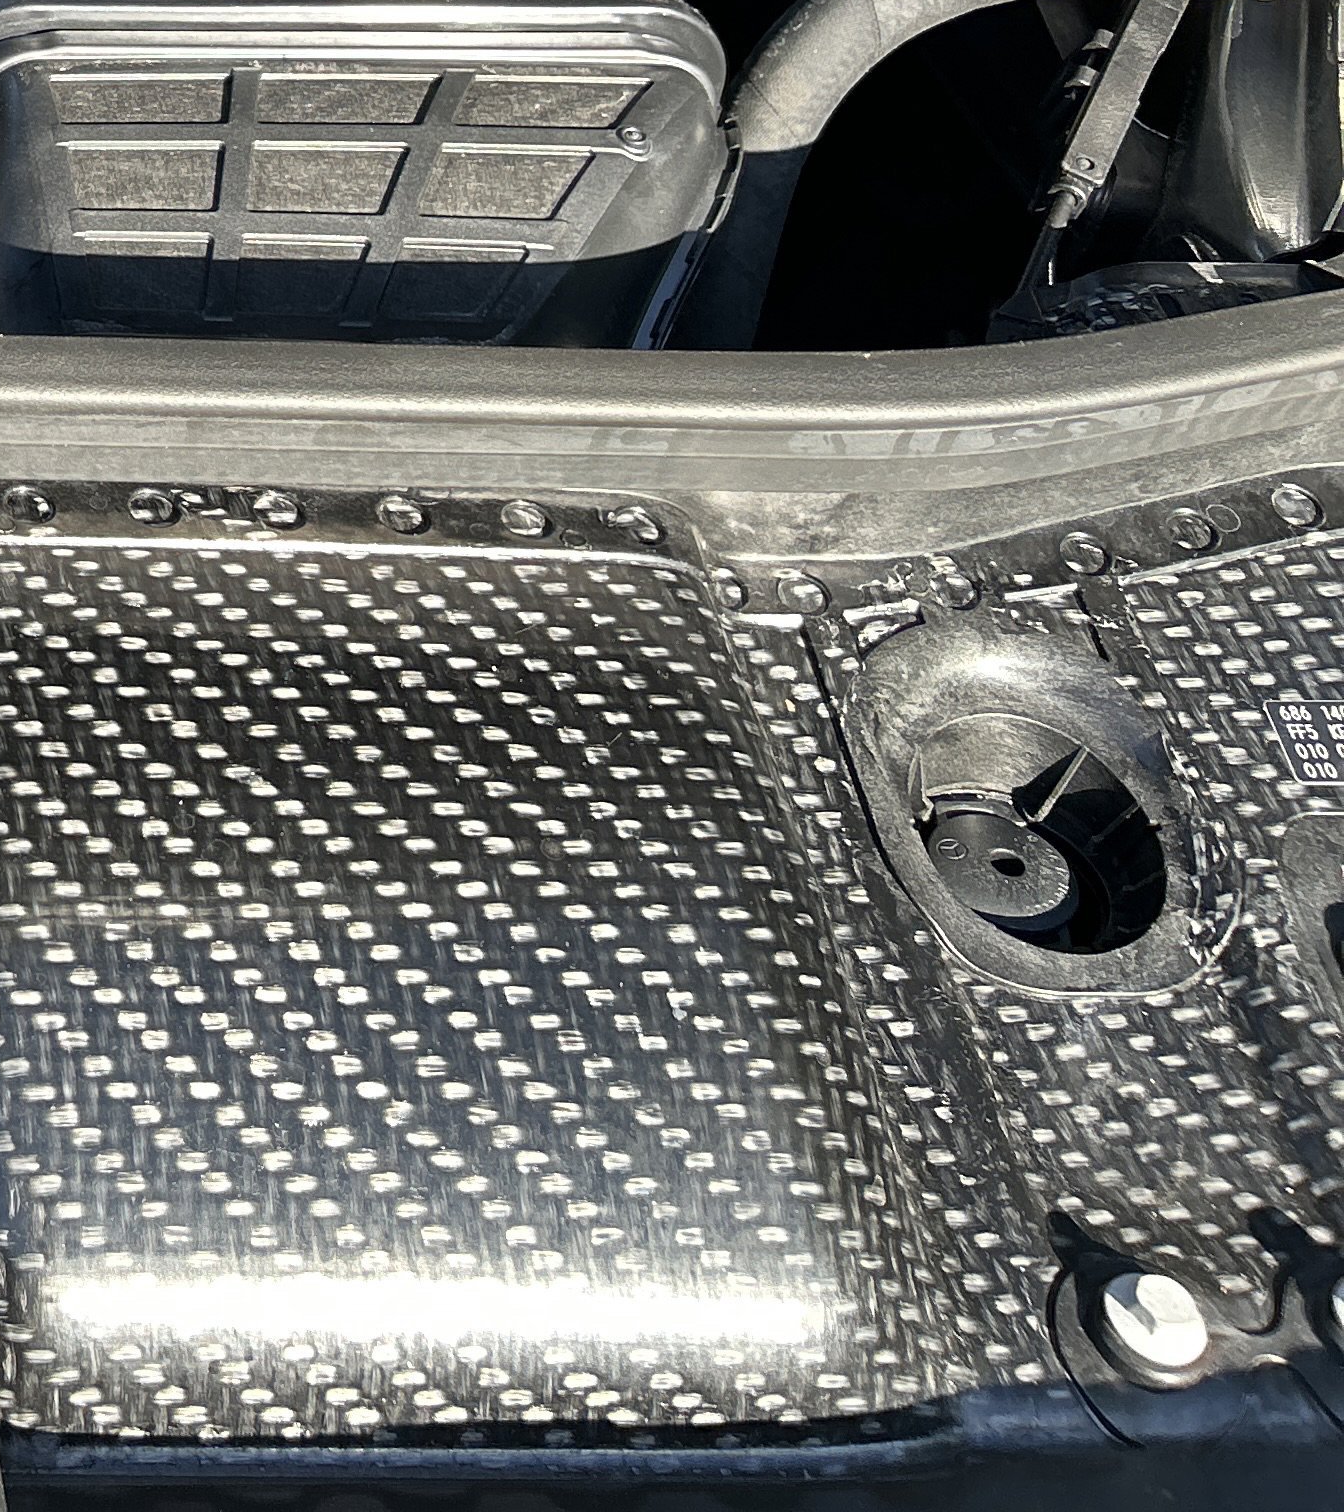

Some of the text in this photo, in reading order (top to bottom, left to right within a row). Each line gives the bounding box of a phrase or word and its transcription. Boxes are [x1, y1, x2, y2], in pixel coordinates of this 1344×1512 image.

[1278, 705, 1313, 722] 686
[1285, 724, 1319, 741] FF5
[1294, 742, 1330, 761] 010
[1302, 761, 1339, 780] 010
